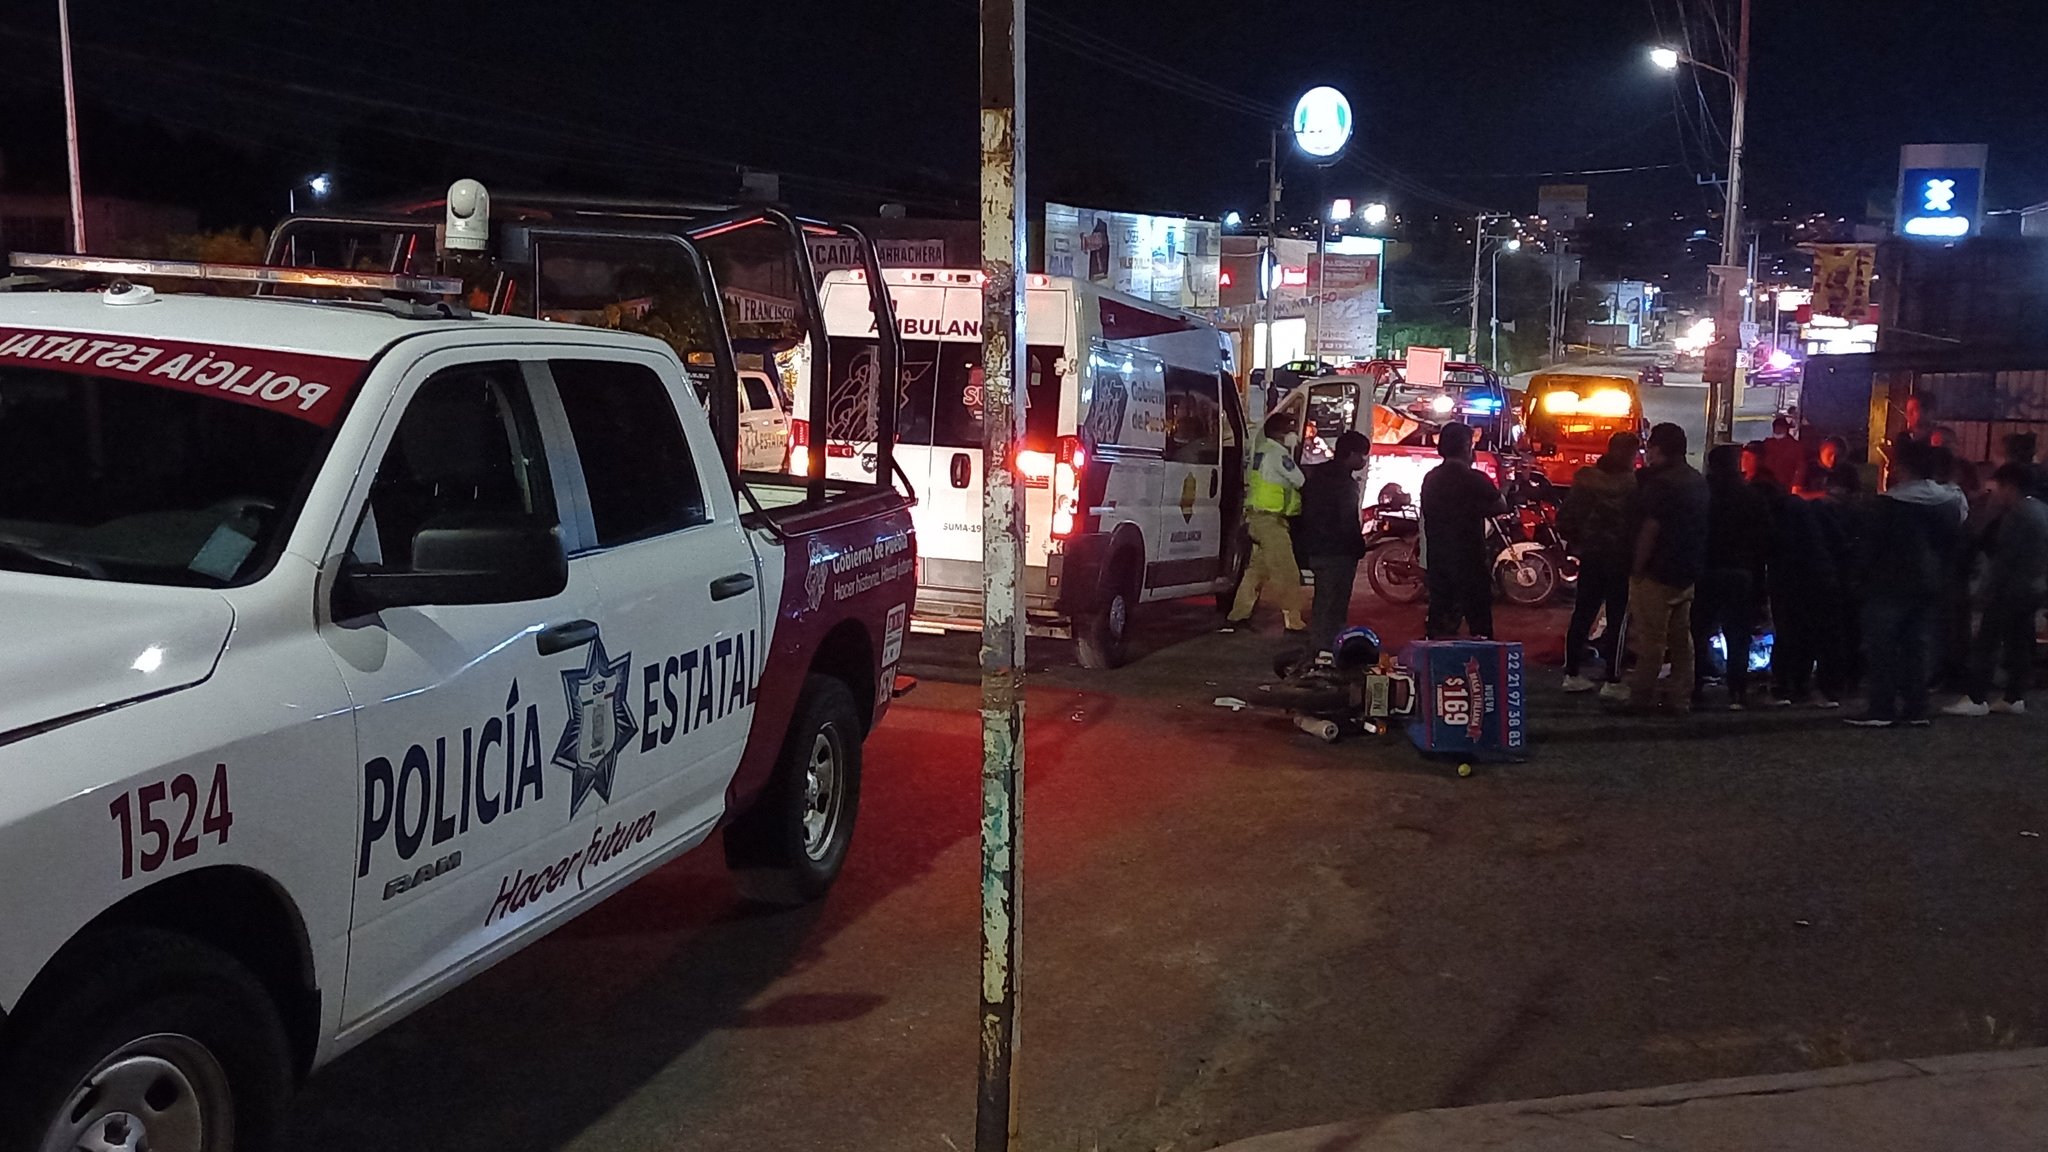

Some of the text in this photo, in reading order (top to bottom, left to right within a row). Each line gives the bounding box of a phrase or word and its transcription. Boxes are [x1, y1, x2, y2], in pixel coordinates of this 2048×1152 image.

[874, 540, 884, 560] de
[1443, 677, 1469, 726] $169
[1484, 684, 1495, 713] NUEVA
[1507, 652, 1521, 747] 22 21 97 38 83
[358, 629, 758, 878] POLICÍA ESTATAL
[109, 763, 233, 880] 1524
[382, 851, 462, 900] RAM
[484, 850, 583, 927] Hacer
